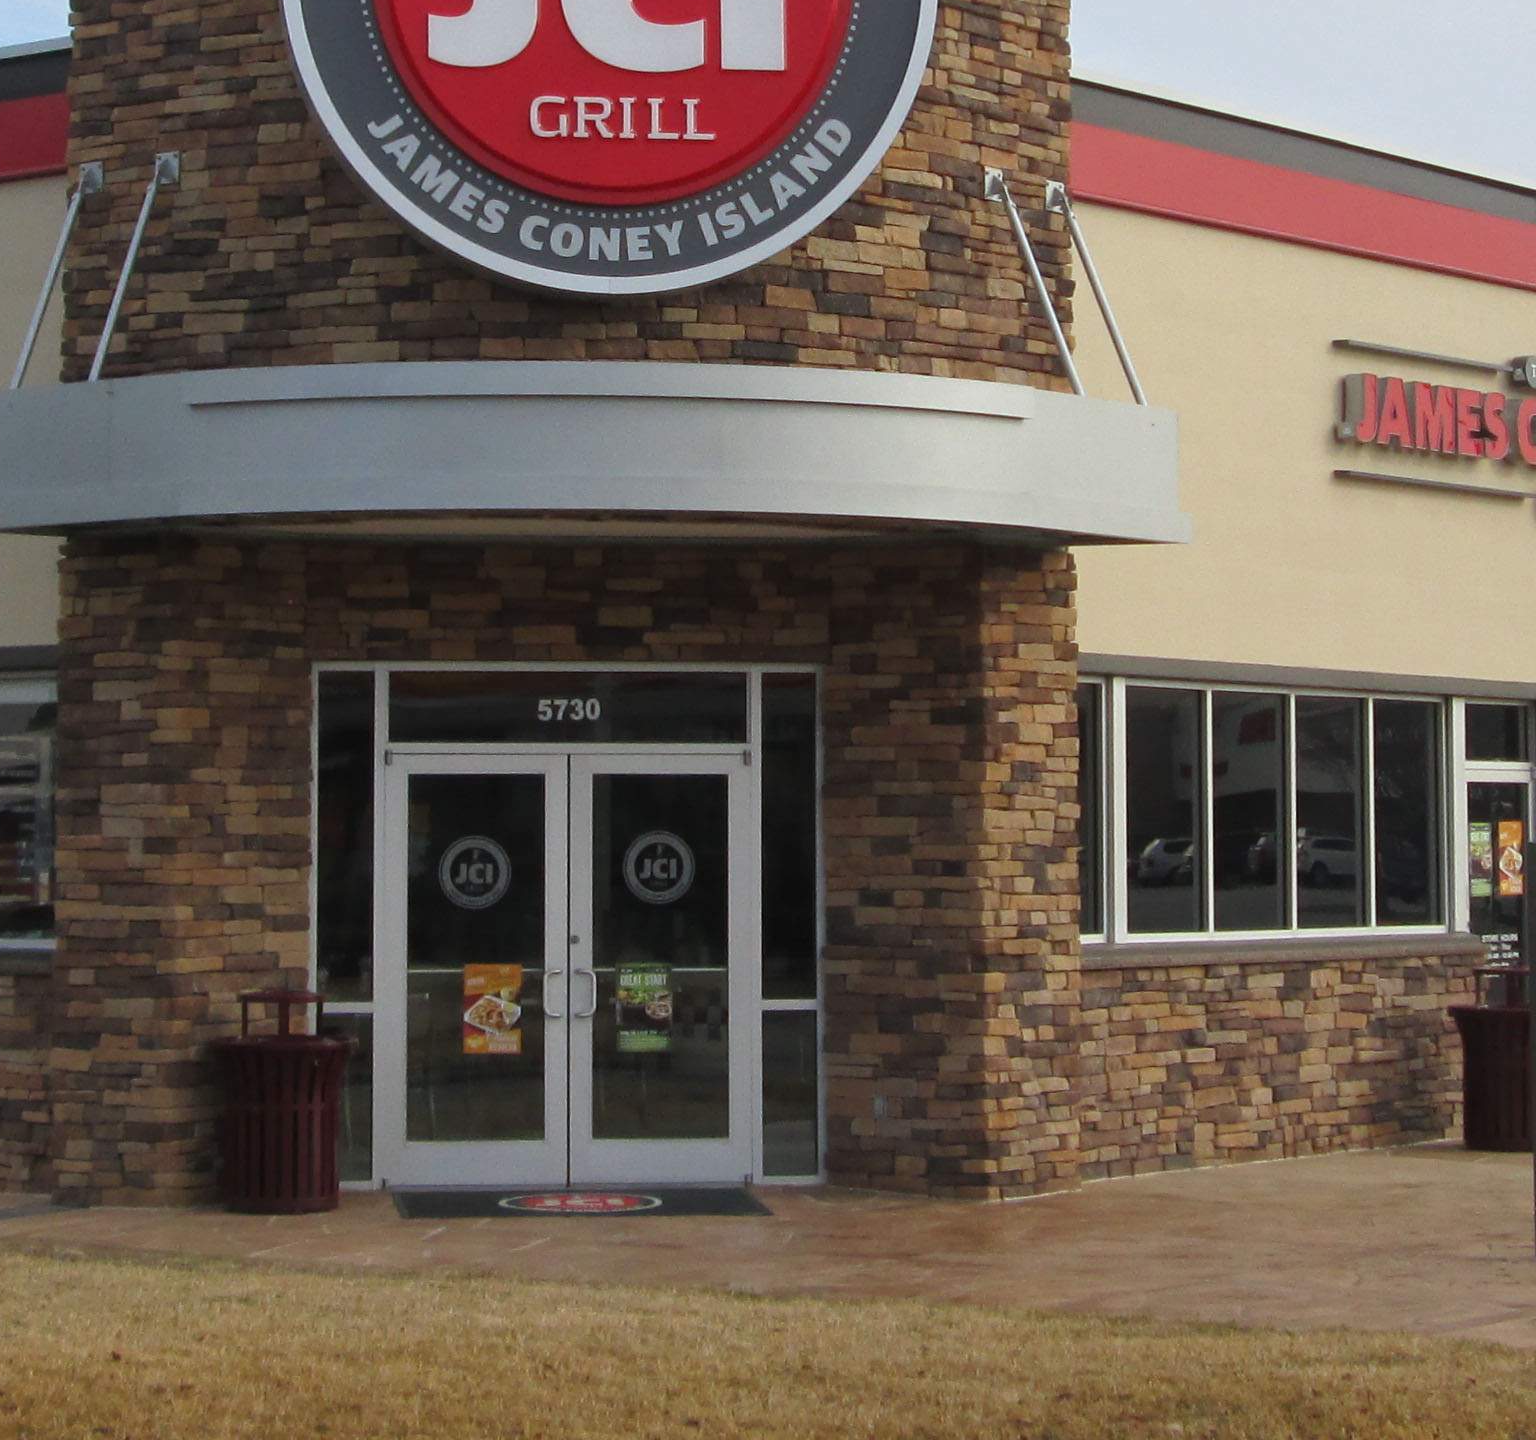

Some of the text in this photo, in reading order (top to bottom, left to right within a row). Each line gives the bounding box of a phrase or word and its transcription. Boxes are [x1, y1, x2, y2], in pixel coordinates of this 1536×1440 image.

[529, 95, 716, 141] GRILL
[368, 113, 853, 261] JAMES CONEY ISLAND
[1356, 372, 1509, 460] JAMES
[537, 699, 601, 721] 5730
[456, 863, 494, 884] JCI
[639, 858, 677, 879] JCI
